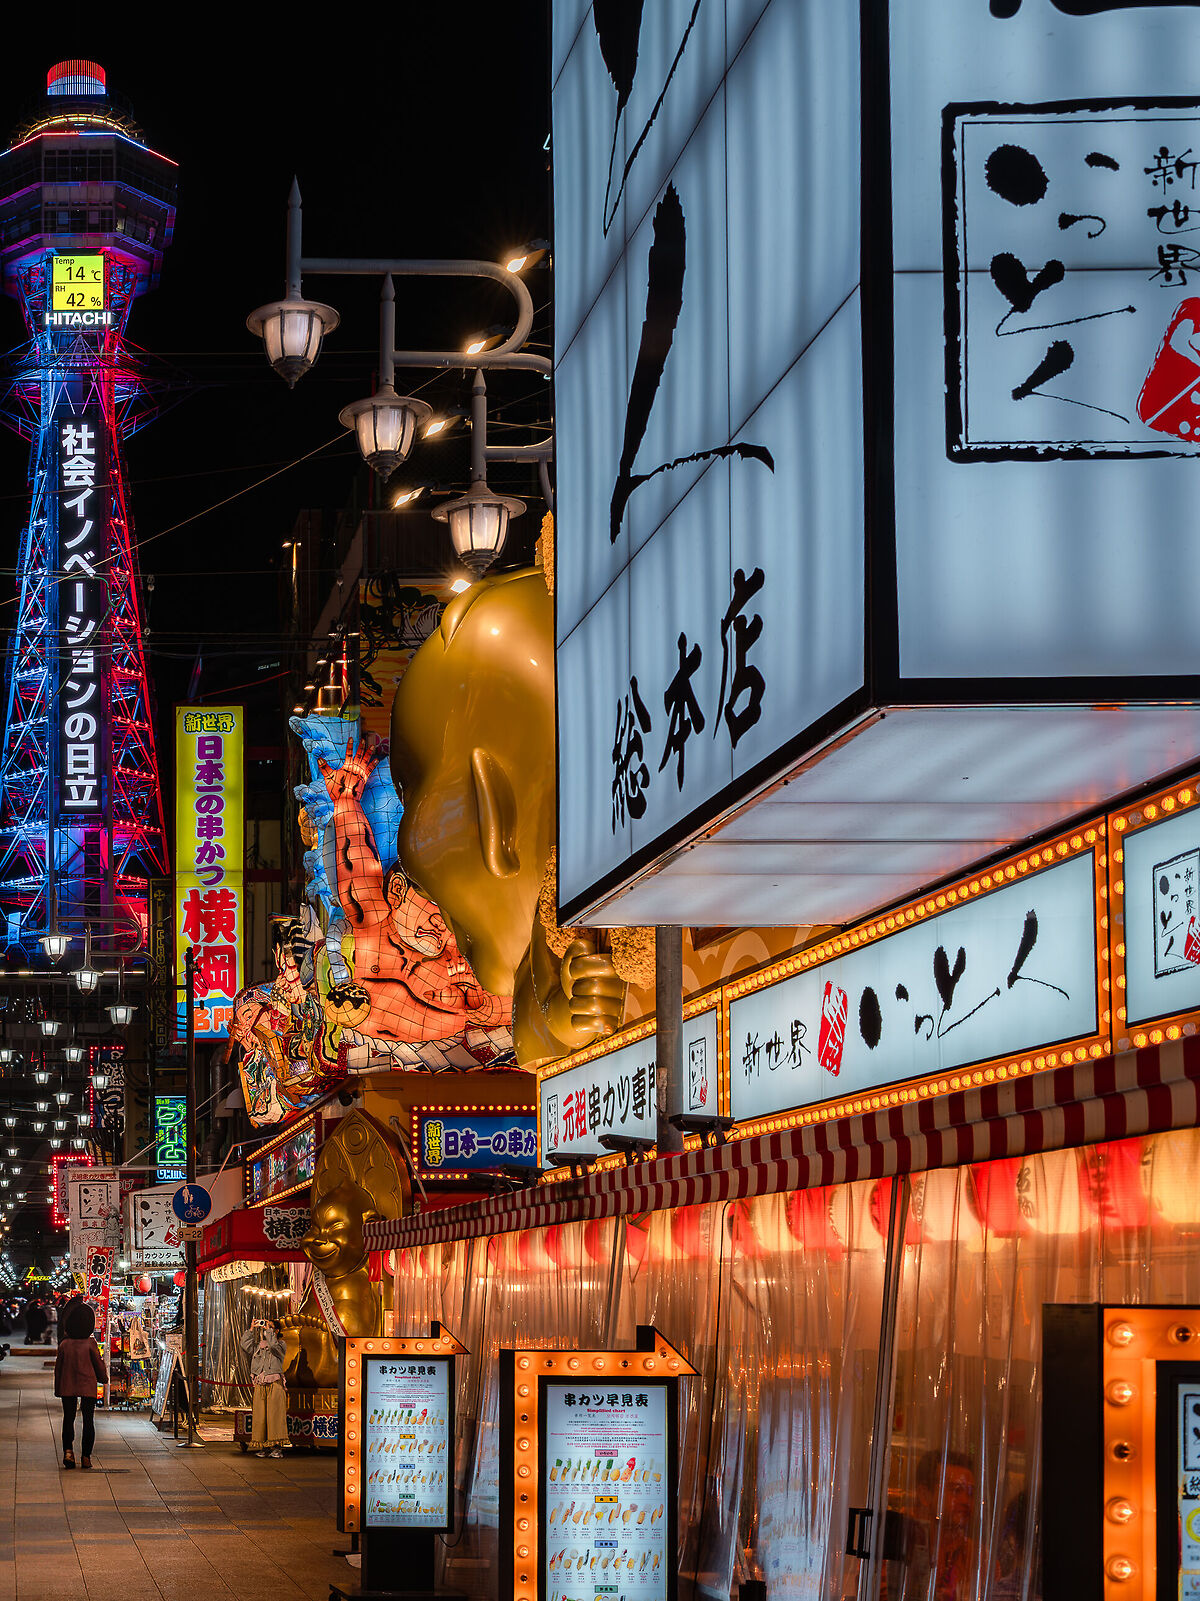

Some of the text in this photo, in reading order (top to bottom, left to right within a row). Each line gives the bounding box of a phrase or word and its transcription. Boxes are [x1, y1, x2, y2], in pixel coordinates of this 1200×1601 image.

[55, 257, 75, 267] Temp
[65, 266, 85, 281] 14
[55, 285, 66, 293] RH
[66, 292, 102, 308] 42 %
[45, 312, 111, 325] HITACHI
[62, 423, 98, 809] 社会イノベーションの日立
[612, 568, 765, 834] 総本店
[184, 712, 235, 733] 新世界
[195, 735, 225, 887] 日本一の串かつ
[181, 888, 238, 1000] 横綱
[742, 1019, 812, 1077] 新世界
[427, 1122, 443, 1165] 新世界
[178, 1230, 202, 1239] 9-22
[379, 1365, 437, 1376] 串カツ早見表
[564, 1393, 649, 1408] 串カツ早見表
